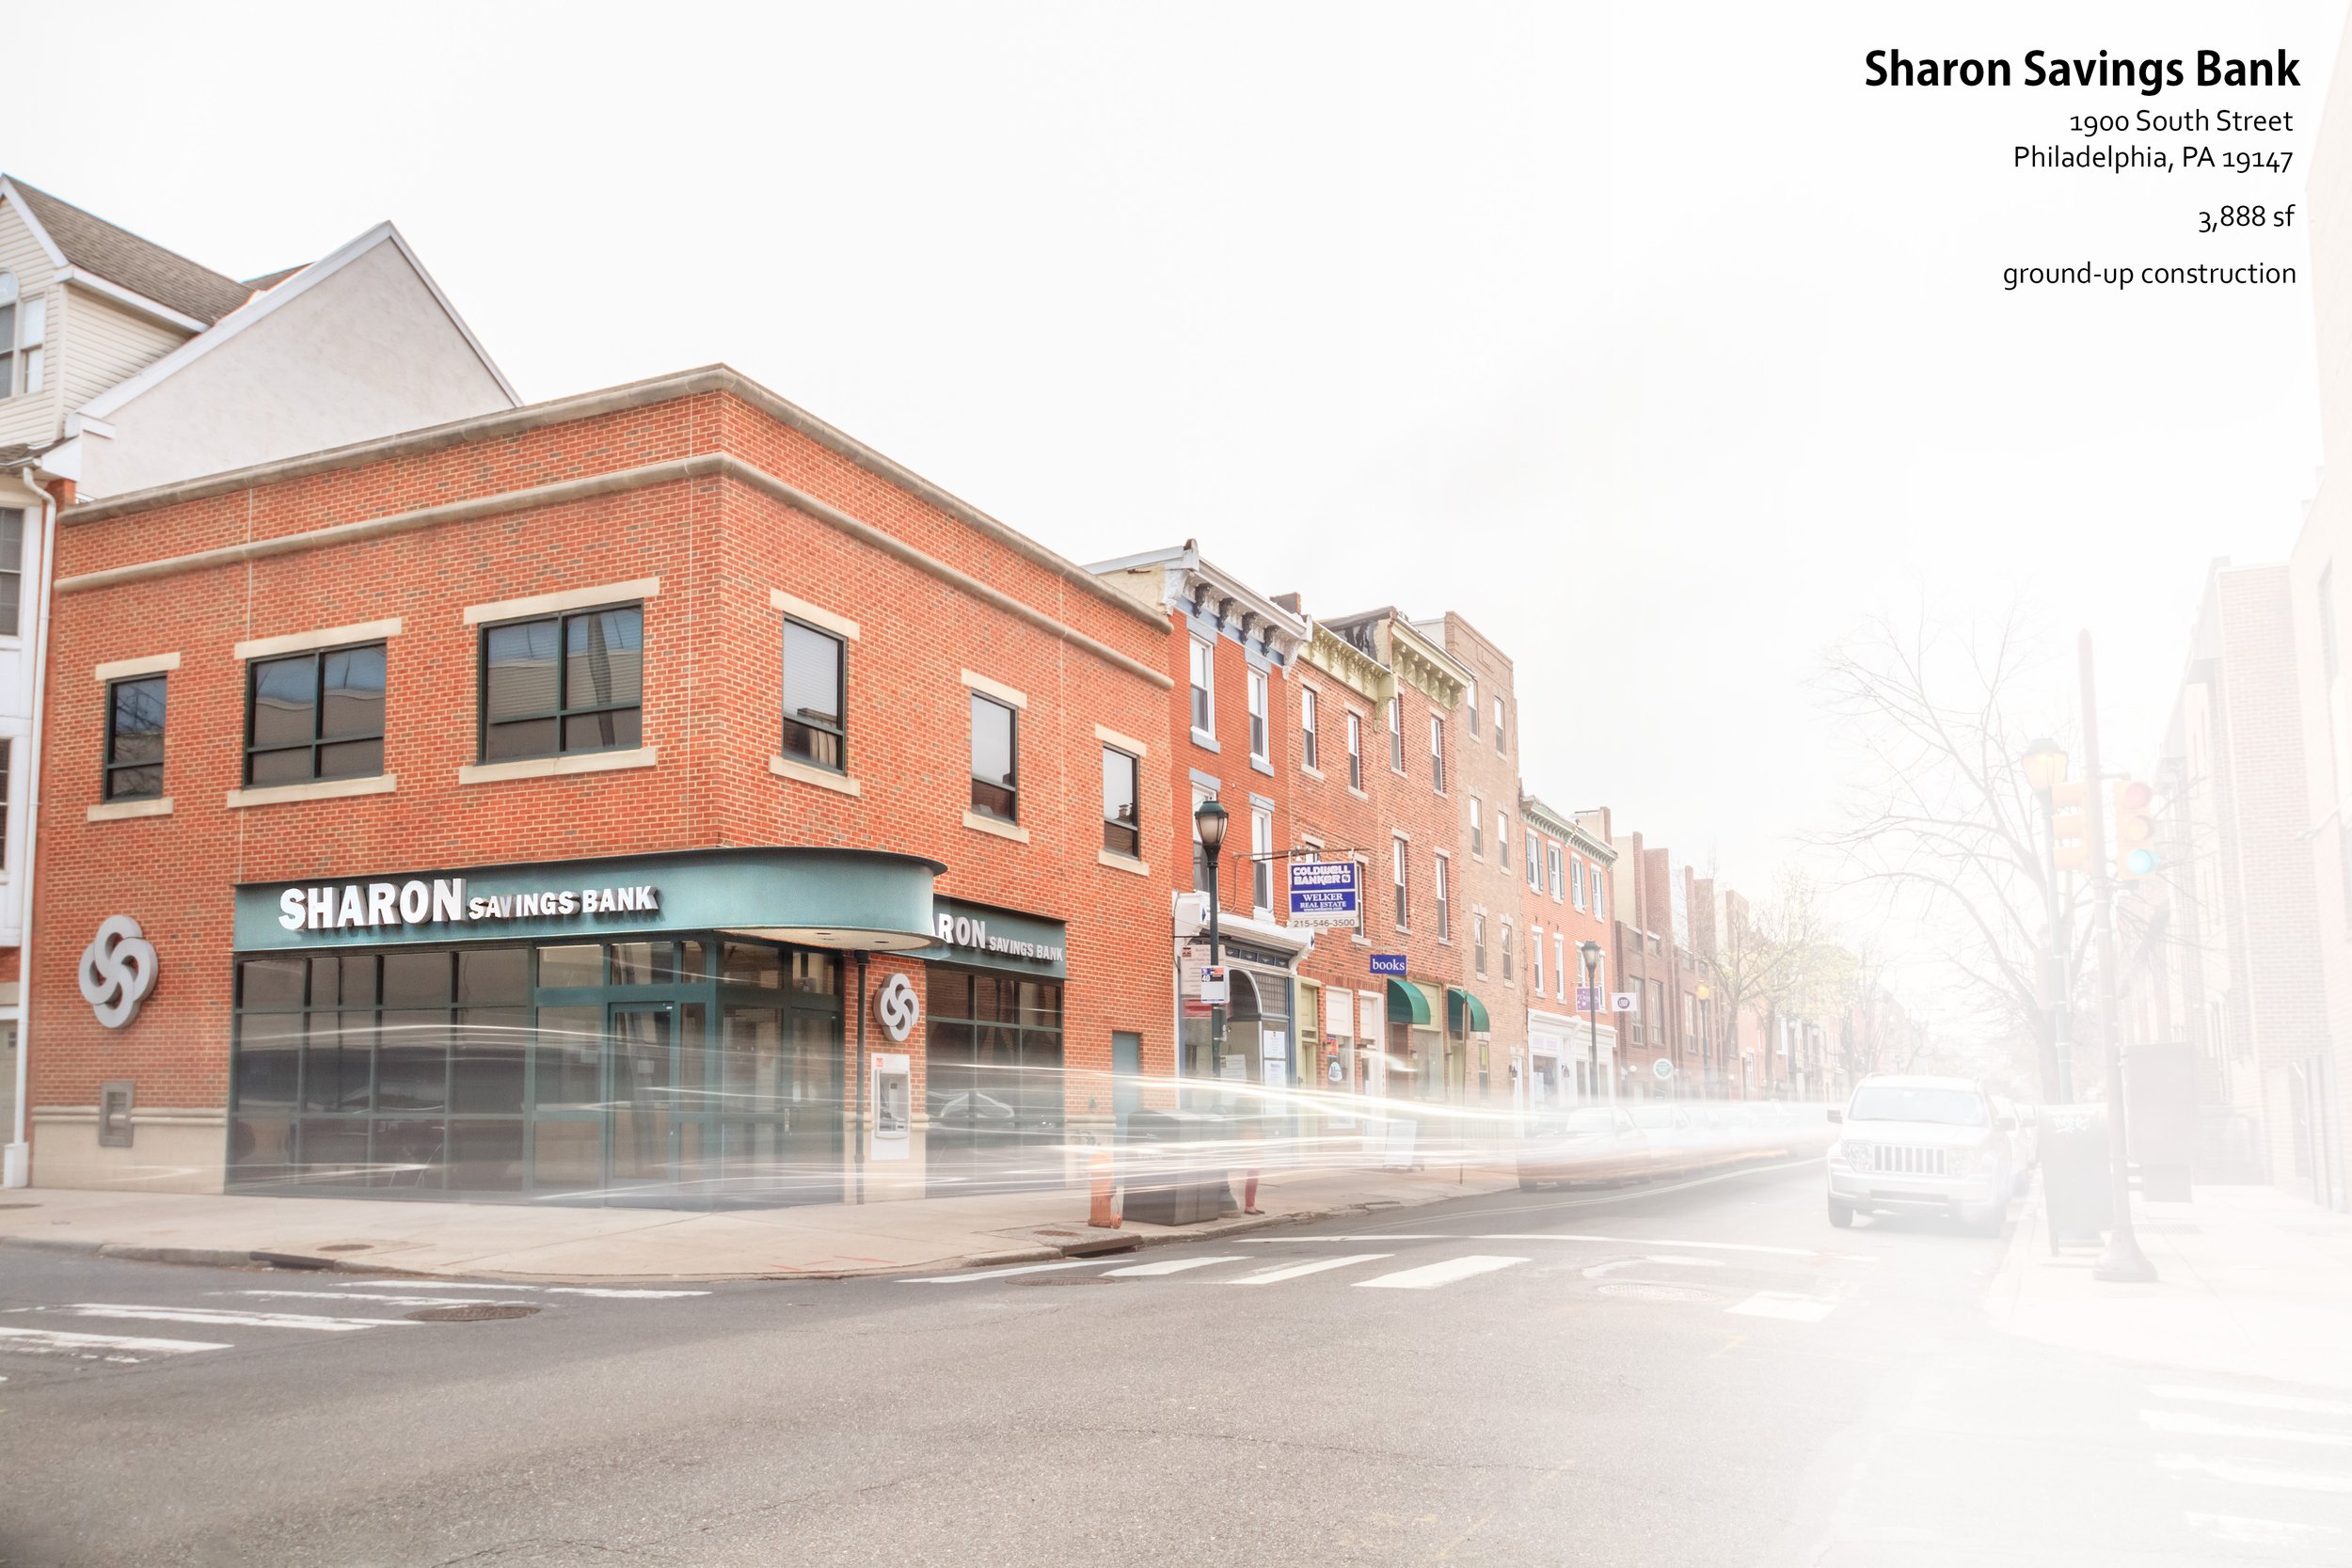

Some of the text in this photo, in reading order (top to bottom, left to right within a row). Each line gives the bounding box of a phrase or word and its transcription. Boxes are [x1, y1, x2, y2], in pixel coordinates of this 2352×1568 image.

[1293, 865, 1351, 876] COLDWELL
[1294, 875, 1341, 885] BANKER
[1302, 893, 1343, 901] WELKER
[278, 879, 659, 930] SHARON SAVINGS BANK
[1294, 919, 1355, 927] 215-546-3500
[989, 936, 1034, 958] SAVINGS
[1036, 944, 1063, 961] BANK
[1372, 958, 1406, 971] books
